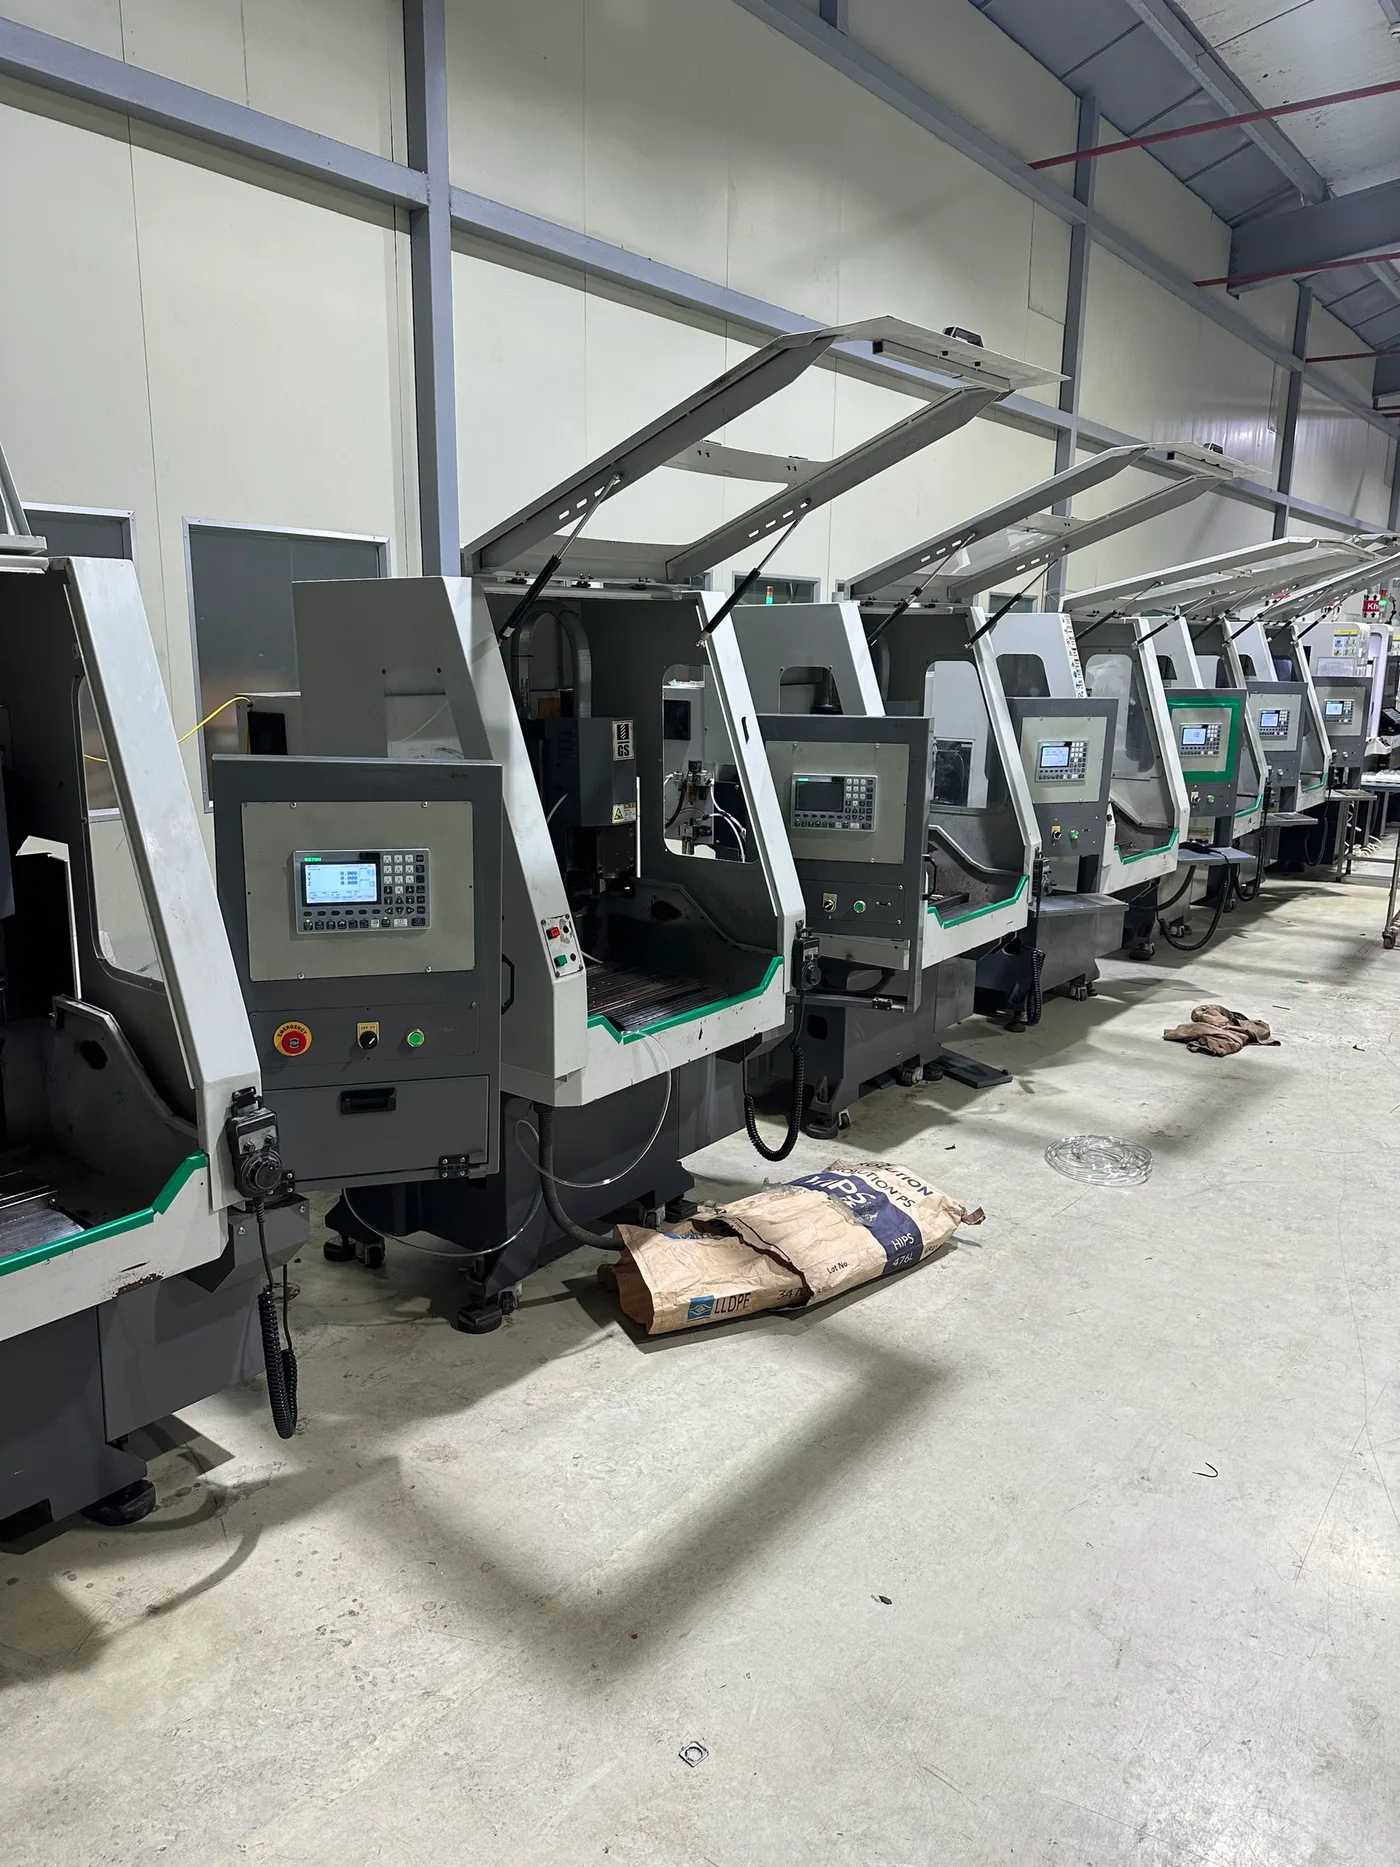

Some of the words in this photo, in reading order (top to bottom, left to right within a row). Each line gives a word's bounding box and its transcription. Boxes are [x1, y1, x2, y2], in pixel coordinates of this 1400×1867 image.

[617, 744, 630, 757] GS
[277, 1024, 308, 1038] EMERGENCY
[896, 1195, 916, 1208] PS
[891, 1232, 915, 1251] HIPS
[892, 1252, 914, 1267] 476L
[826, 1264, 838, 1274] Lot
[838, 1260, 850, 1270] No.
[714, 1292, 752, 1314] LLDPE
